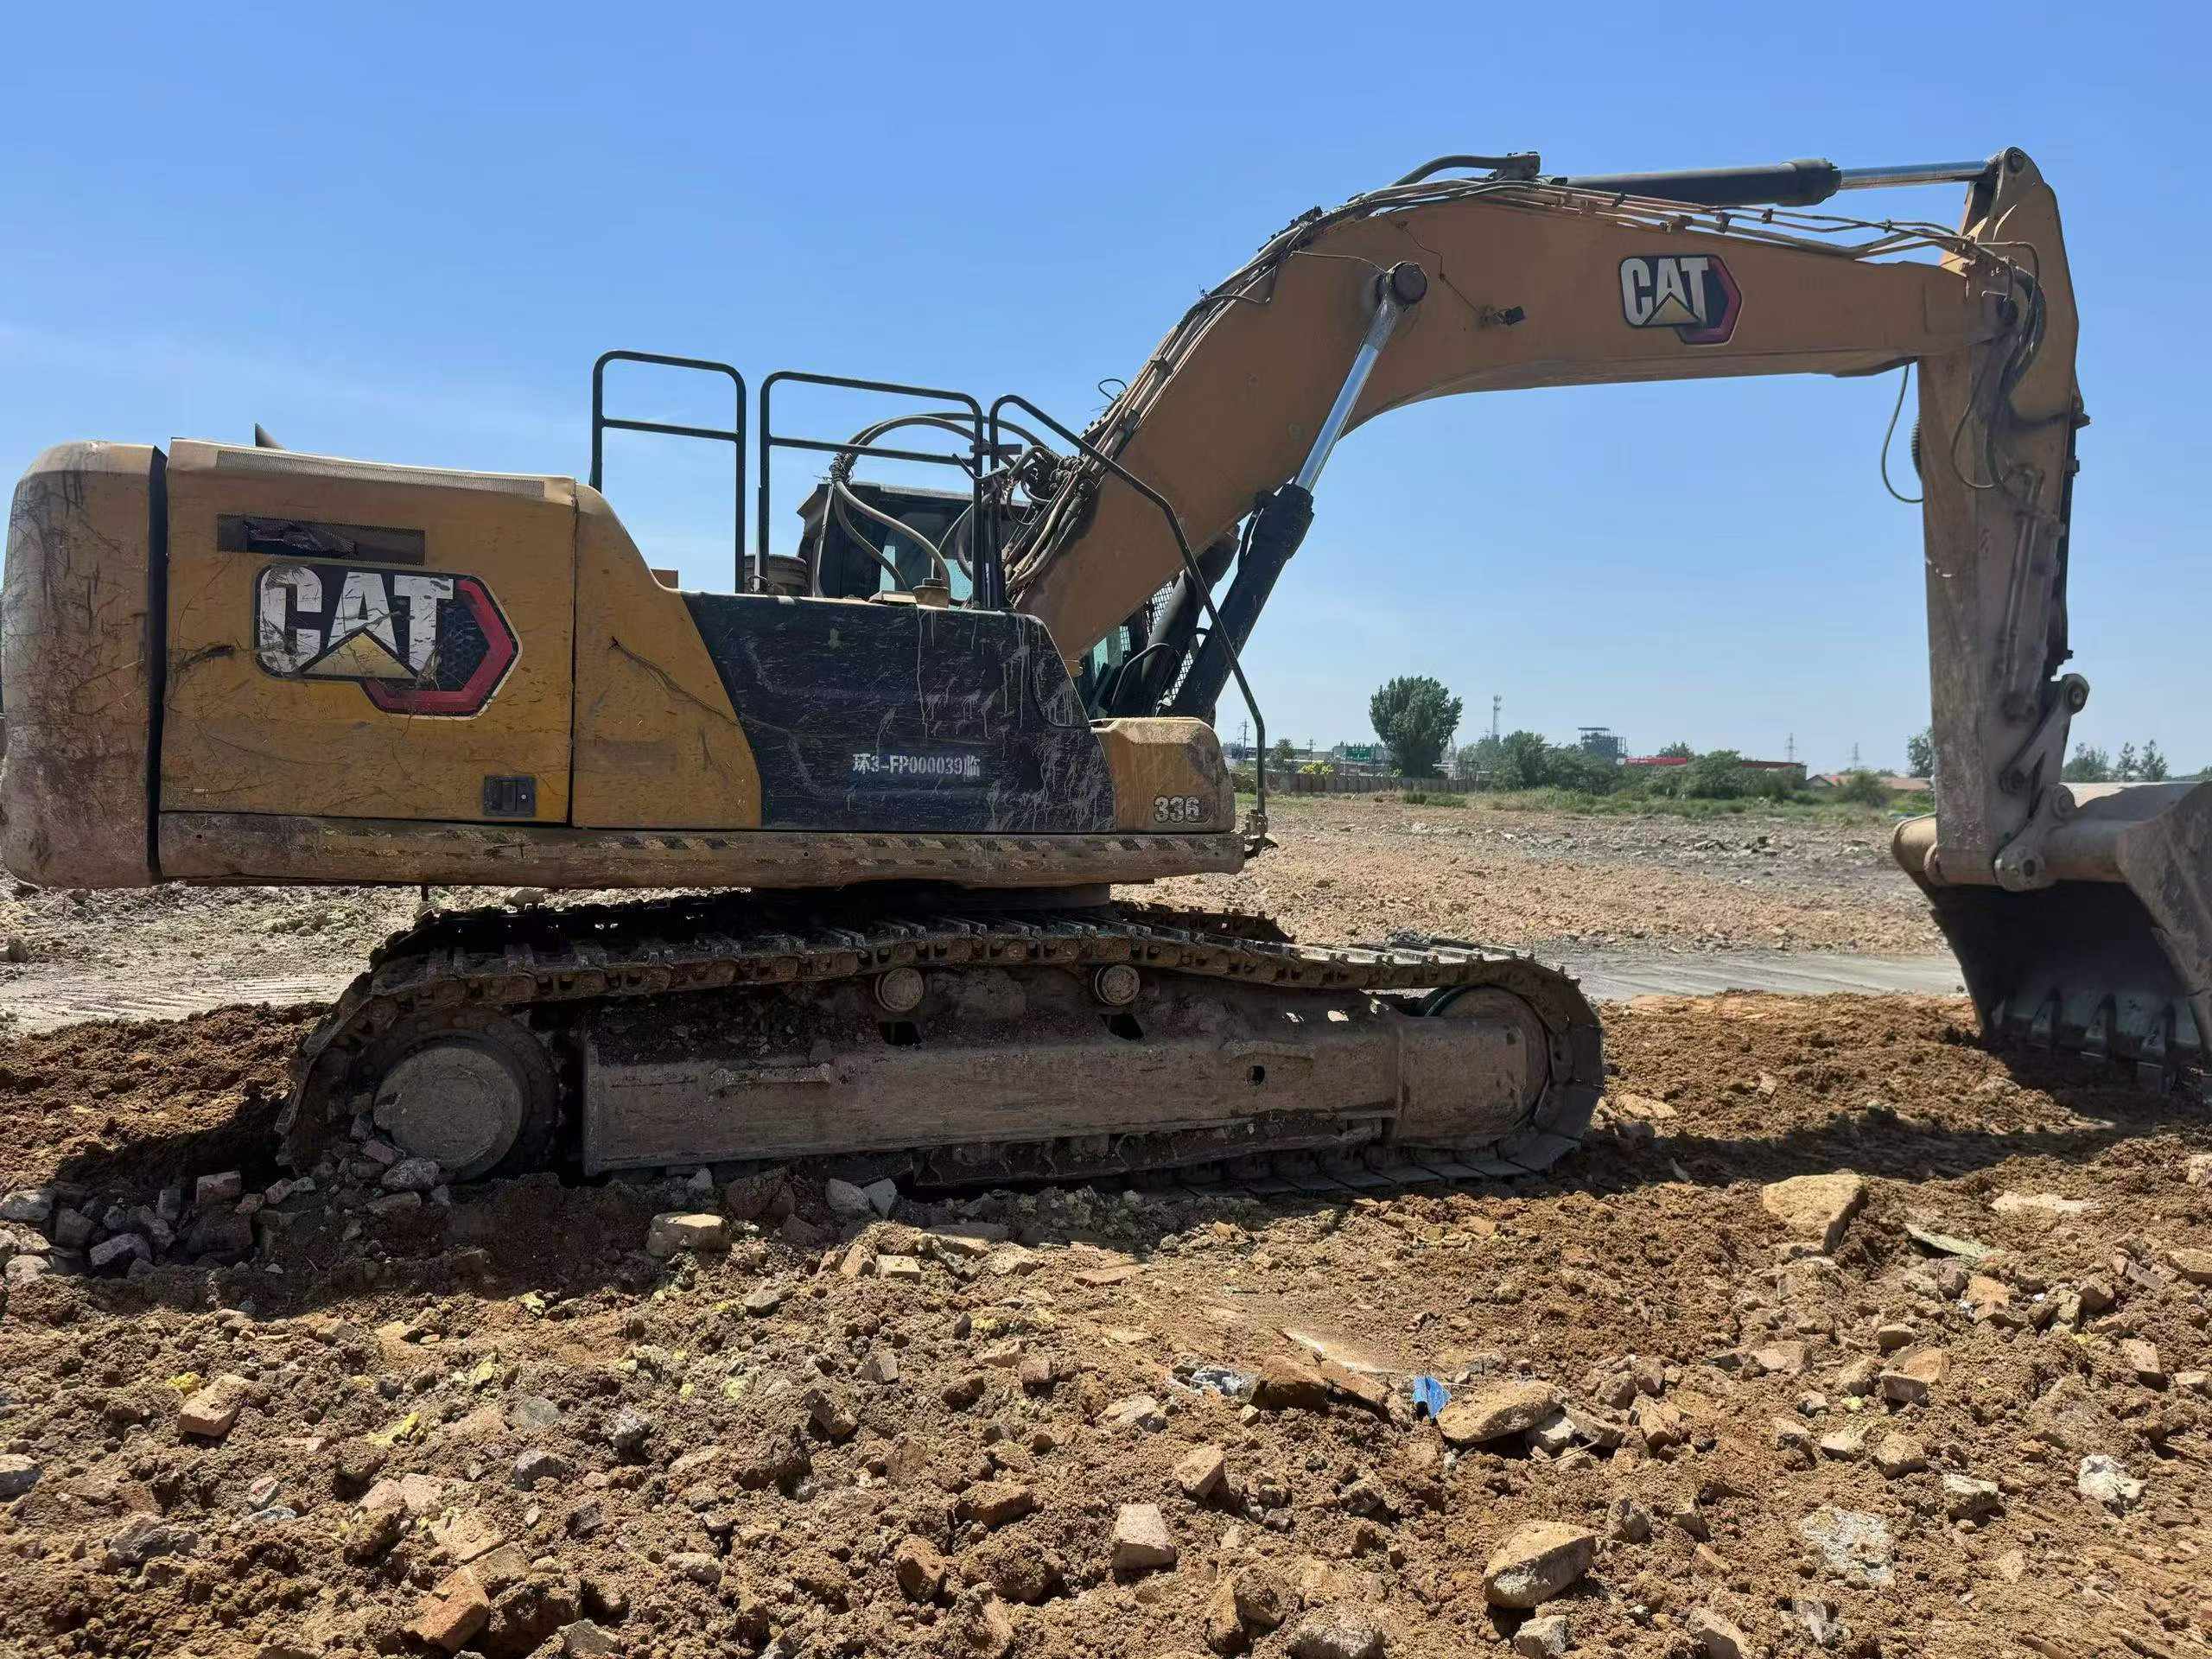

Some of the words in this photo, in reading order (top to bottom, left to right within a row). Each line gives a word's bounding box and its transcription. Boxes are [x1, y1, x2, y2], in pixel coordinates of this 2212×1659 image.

[1620, 257, 1709, 326] CAT
[259, 564, 454, 674] CAT
[1154, 796, 1200, 823] 336
